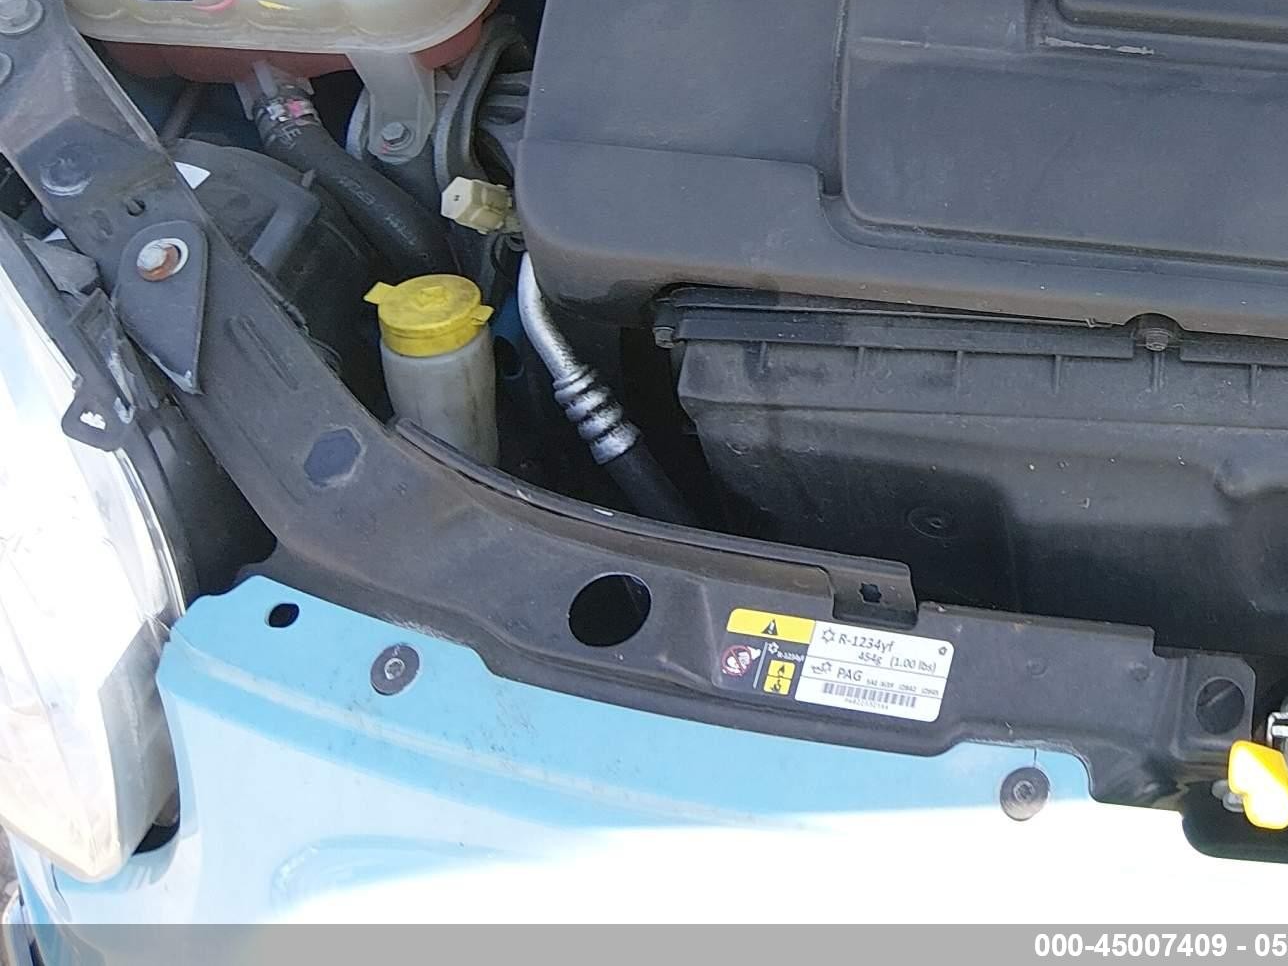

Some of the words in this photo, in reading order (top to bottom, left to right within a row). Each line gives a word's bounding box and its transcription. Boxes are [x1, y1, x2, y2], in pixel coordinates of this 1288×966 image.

[838, 634, 896, 653] R-1234yf
[890, 656, 916, 670] (1.00
[837, 667, 864, 682] PAG
